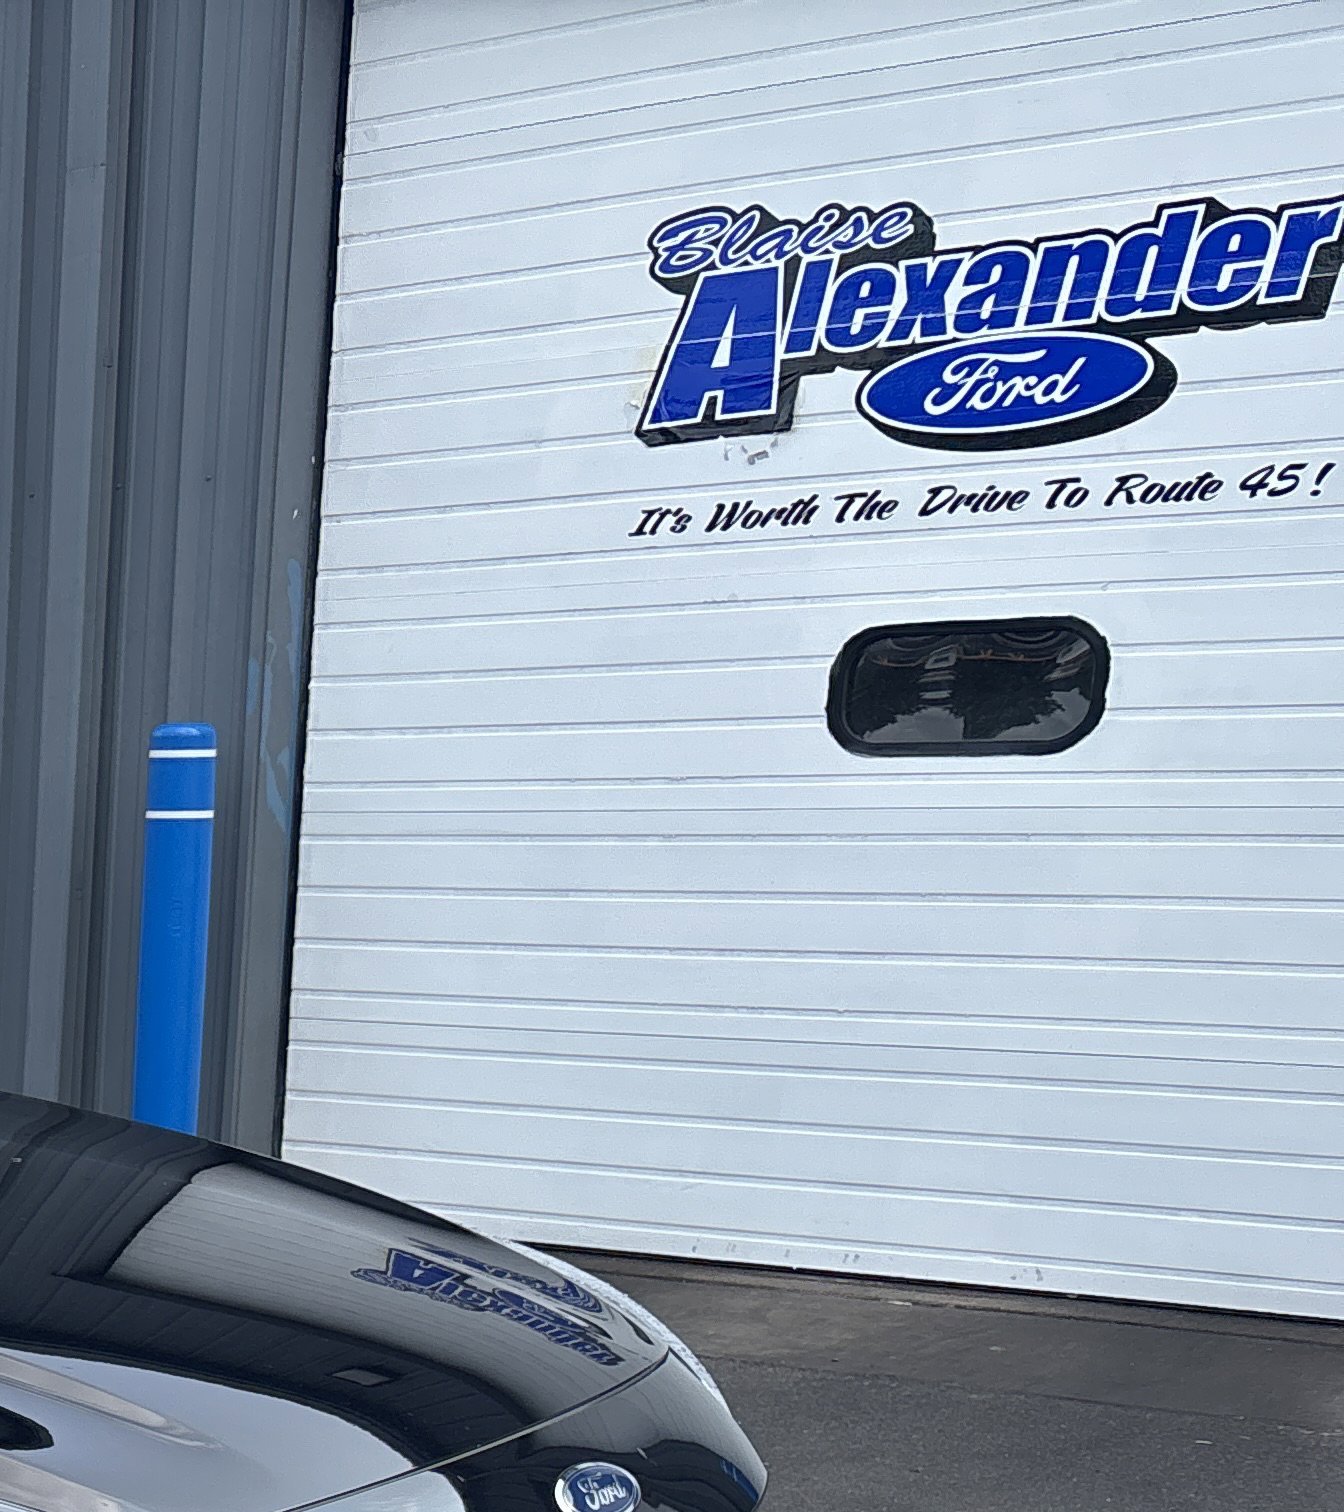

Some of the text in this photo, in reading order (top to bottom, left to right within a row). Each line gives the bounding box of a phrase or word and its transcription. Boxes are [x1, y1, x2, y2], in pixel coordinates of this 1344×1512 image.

[652, 206, 916, 280] Blaise
[640, 200, 1344, 432] Alexander
[922, 348, 1090, 416] Ford
[627, 506, 694, 537] It's
[704, 493, 820, 533] Worth
[833, 489, 900, 524] The
[917, 484, 1031, 517] Drive
[1043, 476, 1090, 510] To
[1103, 471, 1225, 508] Route
[576, 1471, 627, 1511] Ford
